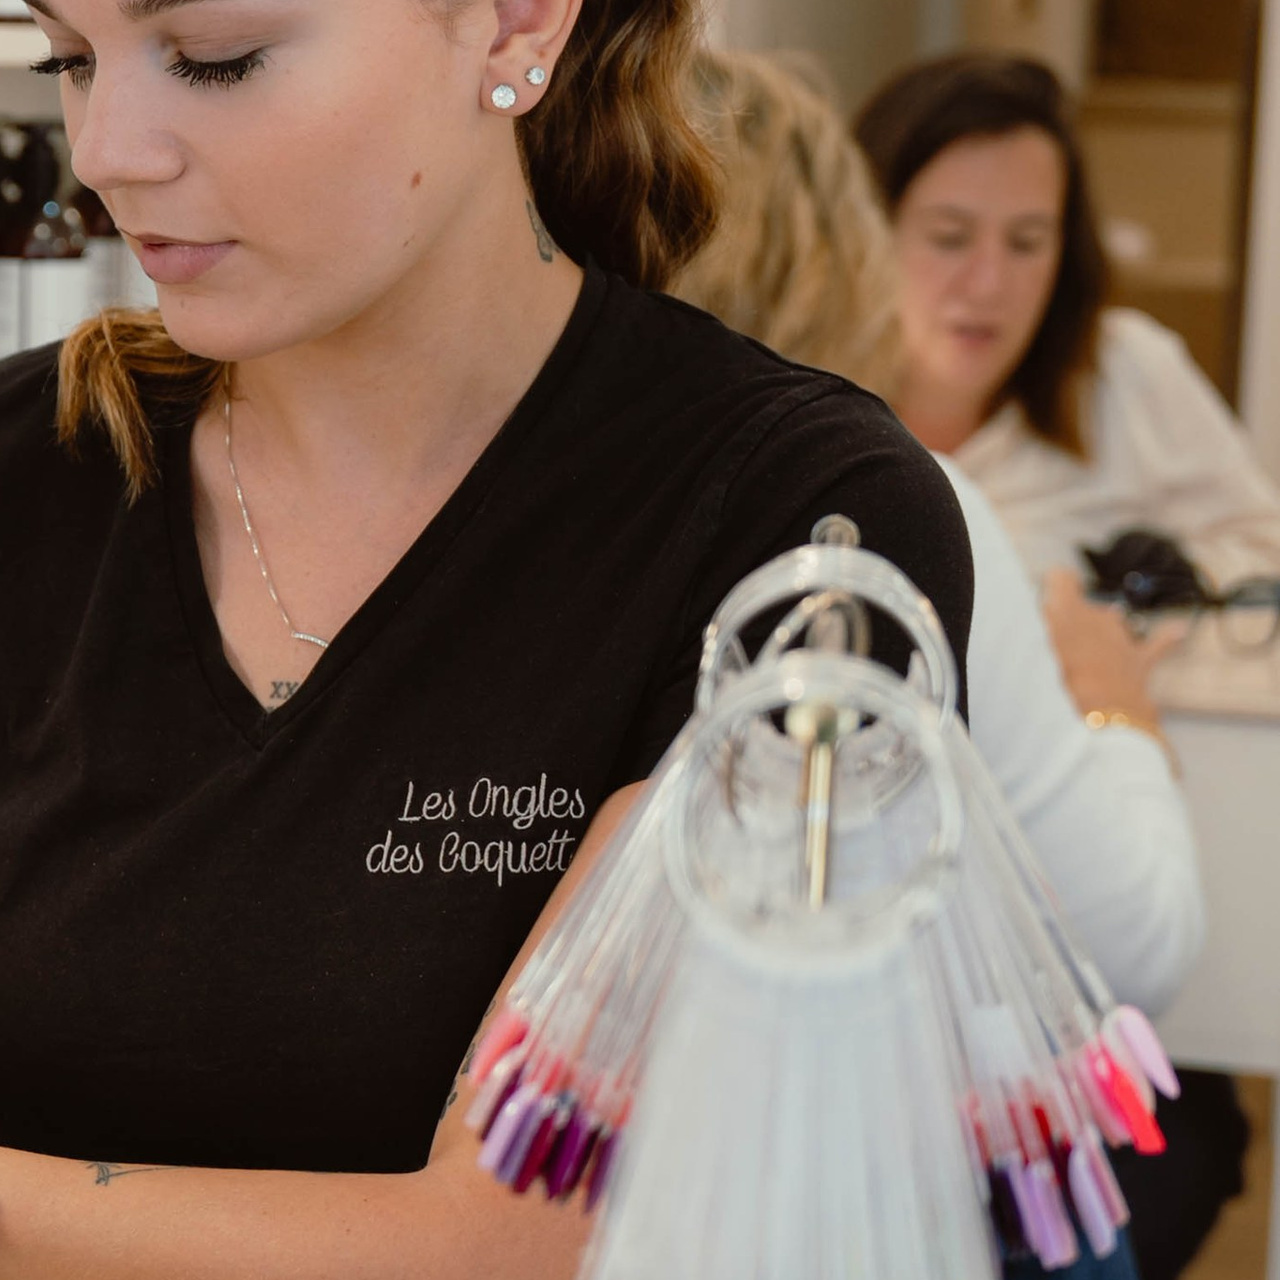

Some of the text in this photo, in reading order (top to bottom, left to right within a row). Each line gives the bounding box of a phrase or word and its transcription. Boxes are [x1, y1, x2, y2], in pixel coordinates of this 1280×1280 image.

[398, 772, 585, 830] Les Ongles
[365, 829, 424, 874] des
